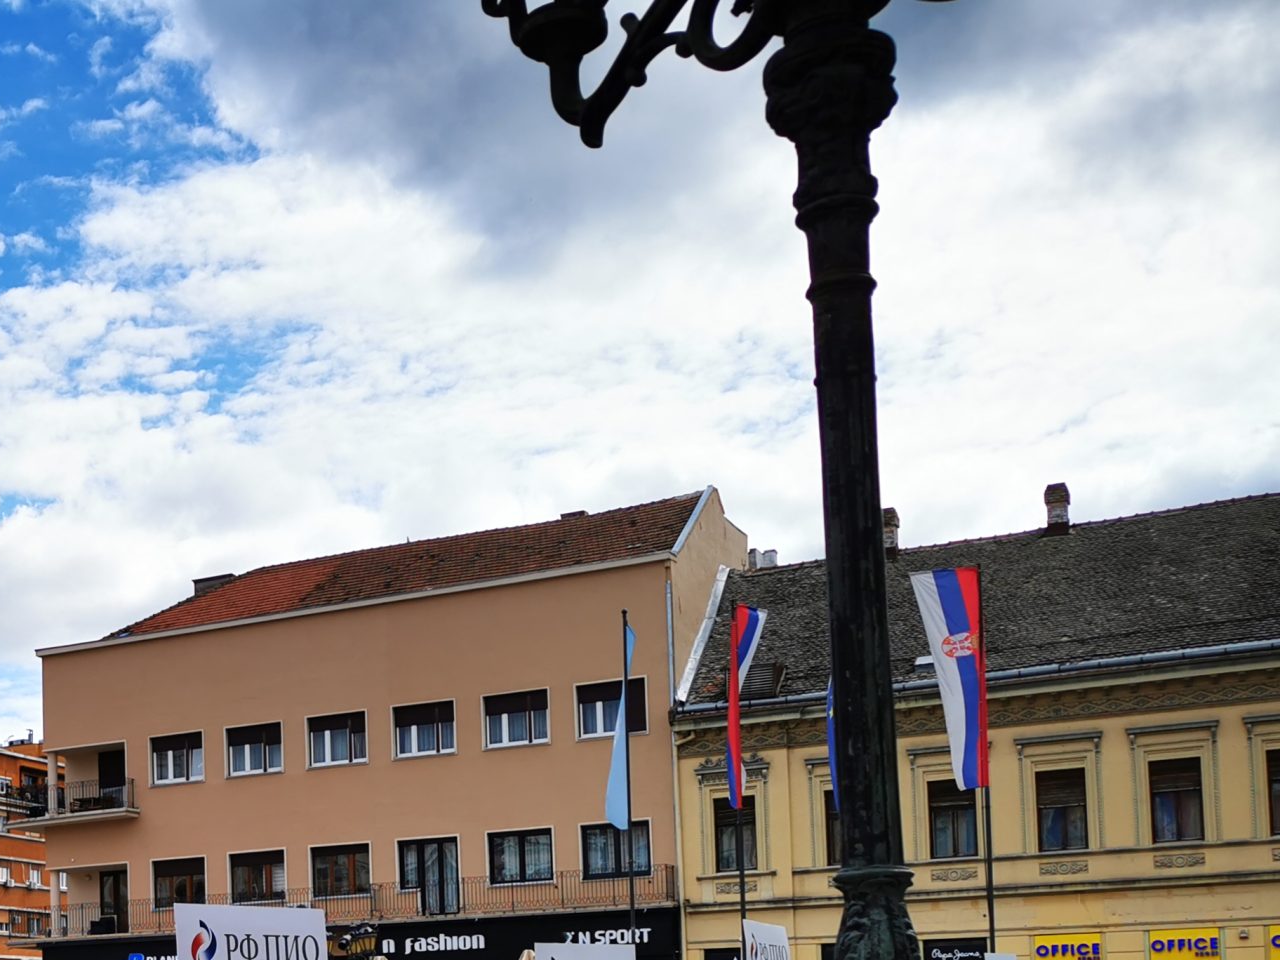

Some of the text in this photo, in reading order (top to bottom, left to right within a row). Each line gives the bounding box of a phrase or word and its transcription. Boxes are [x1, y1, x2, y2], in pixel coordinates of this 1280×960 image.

[594, 928, 652, 944] SPORT
[1036, 943, 1100, 957] OFFICE
[1151, 937, 1219, 953] OFFICE
